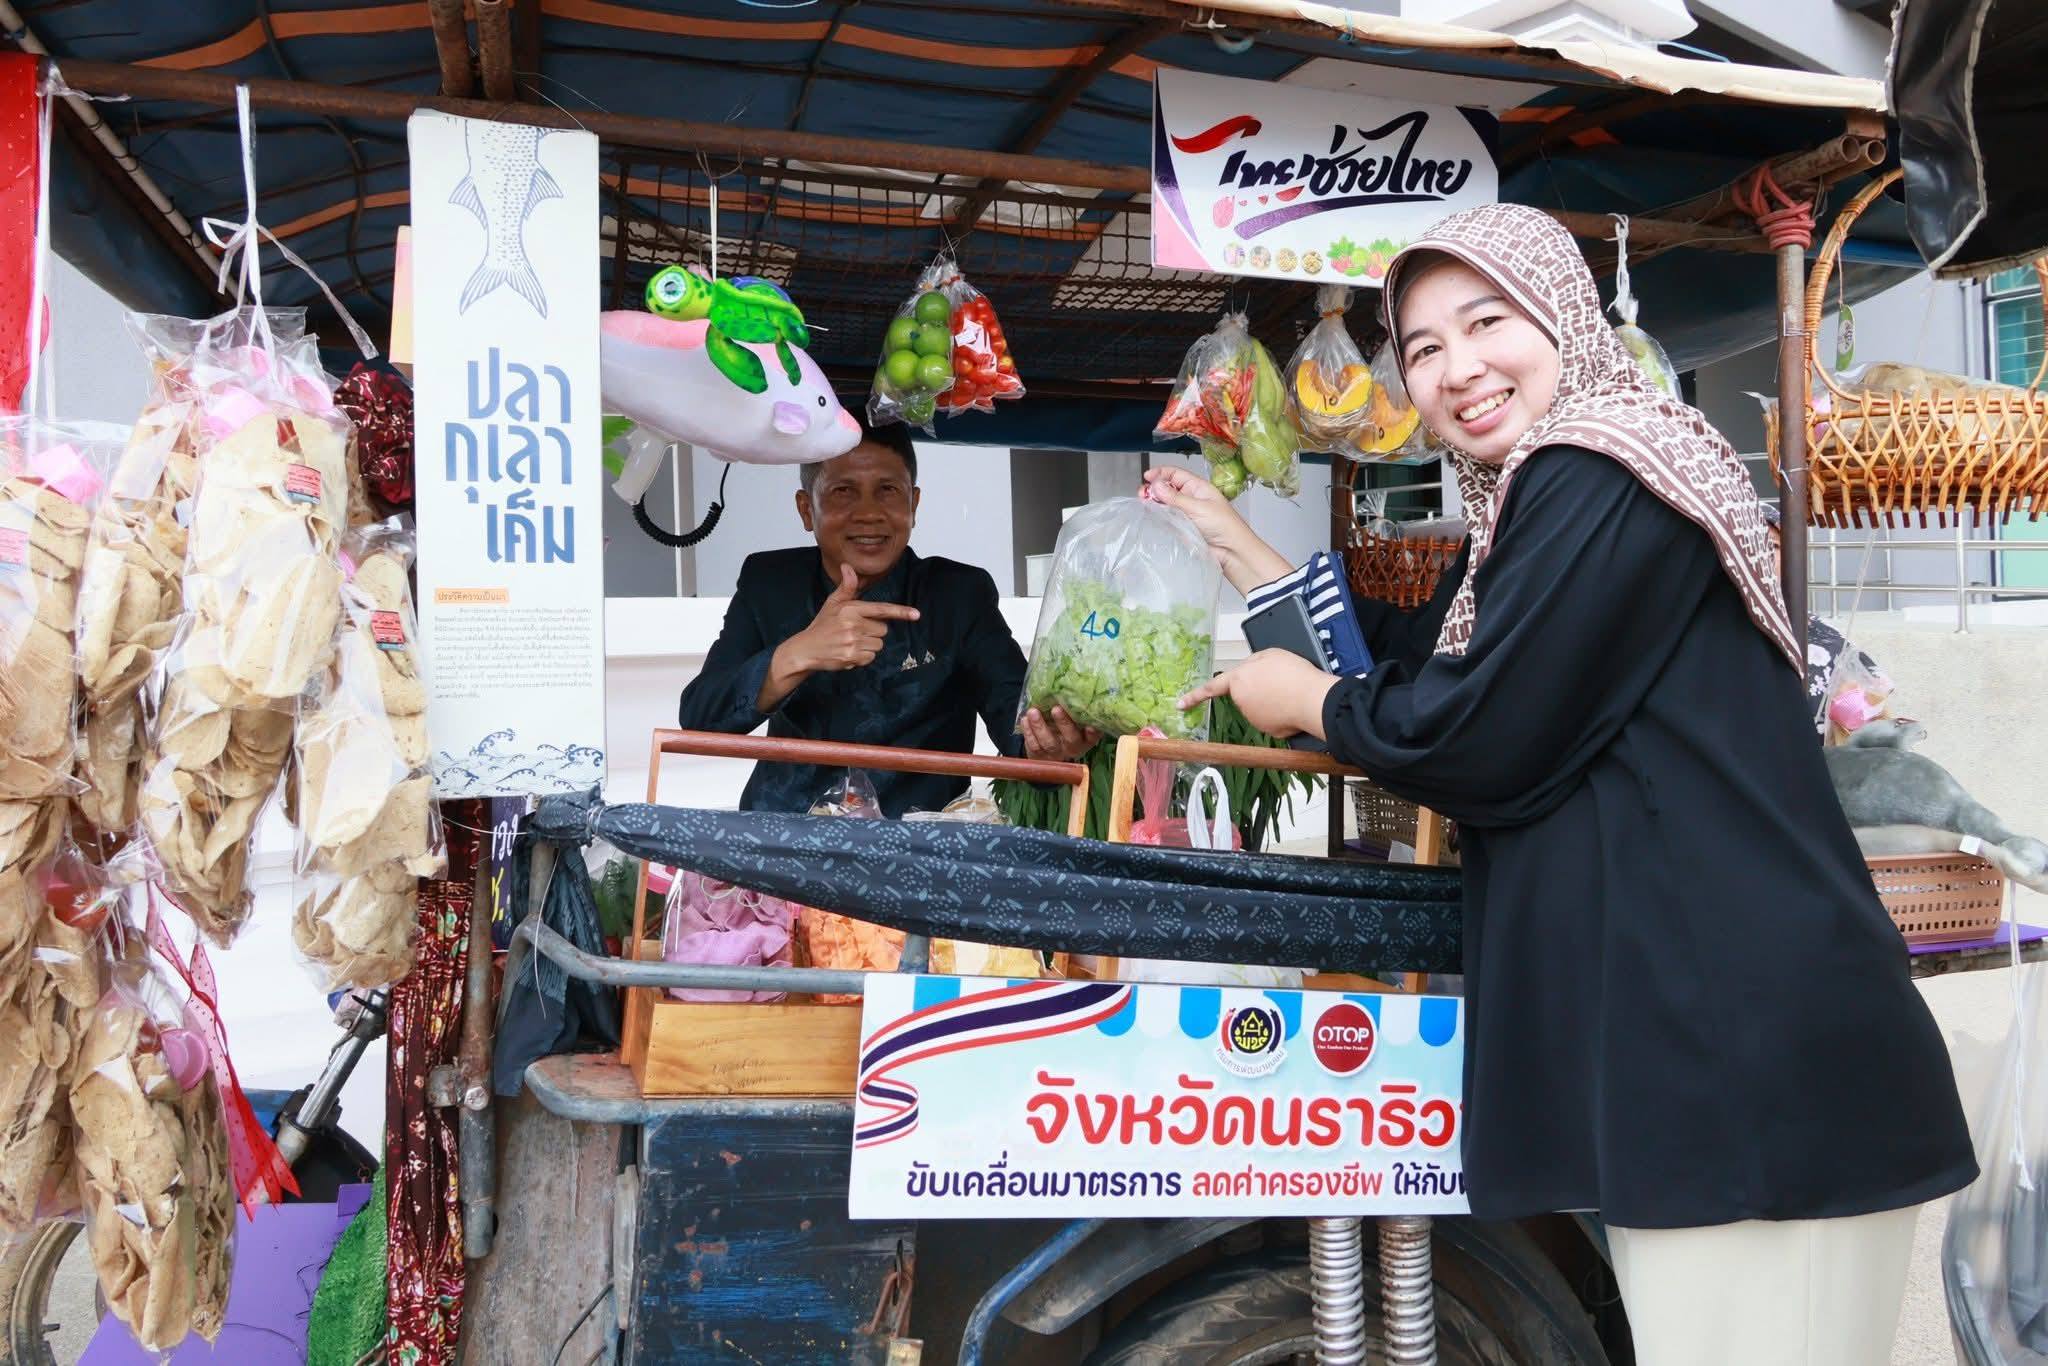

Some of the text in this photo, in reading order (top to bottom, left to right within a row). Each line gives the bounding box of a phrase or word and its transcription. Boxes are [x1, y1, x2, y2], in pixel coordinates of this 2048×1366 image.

[1170, 111, 1473, 196] ไทยช่วยไทย
[467, 346, 572, 424] ปลา
[445, 421, 573, 504] กุเลา
[486, 487, 575, 564] เค็ม
[1079, 609, 1121, 641] 40
[1317, 1025, 1370, 1043] OTOP
[1026, 1070, 1464, 1147] จังหวัดนราธิว
[906, 1150, 1182, 1198] ขับเคลื่อนมาตรการ
[1192, 1161, 1383, 1198] ลดค่าครองชีพ
